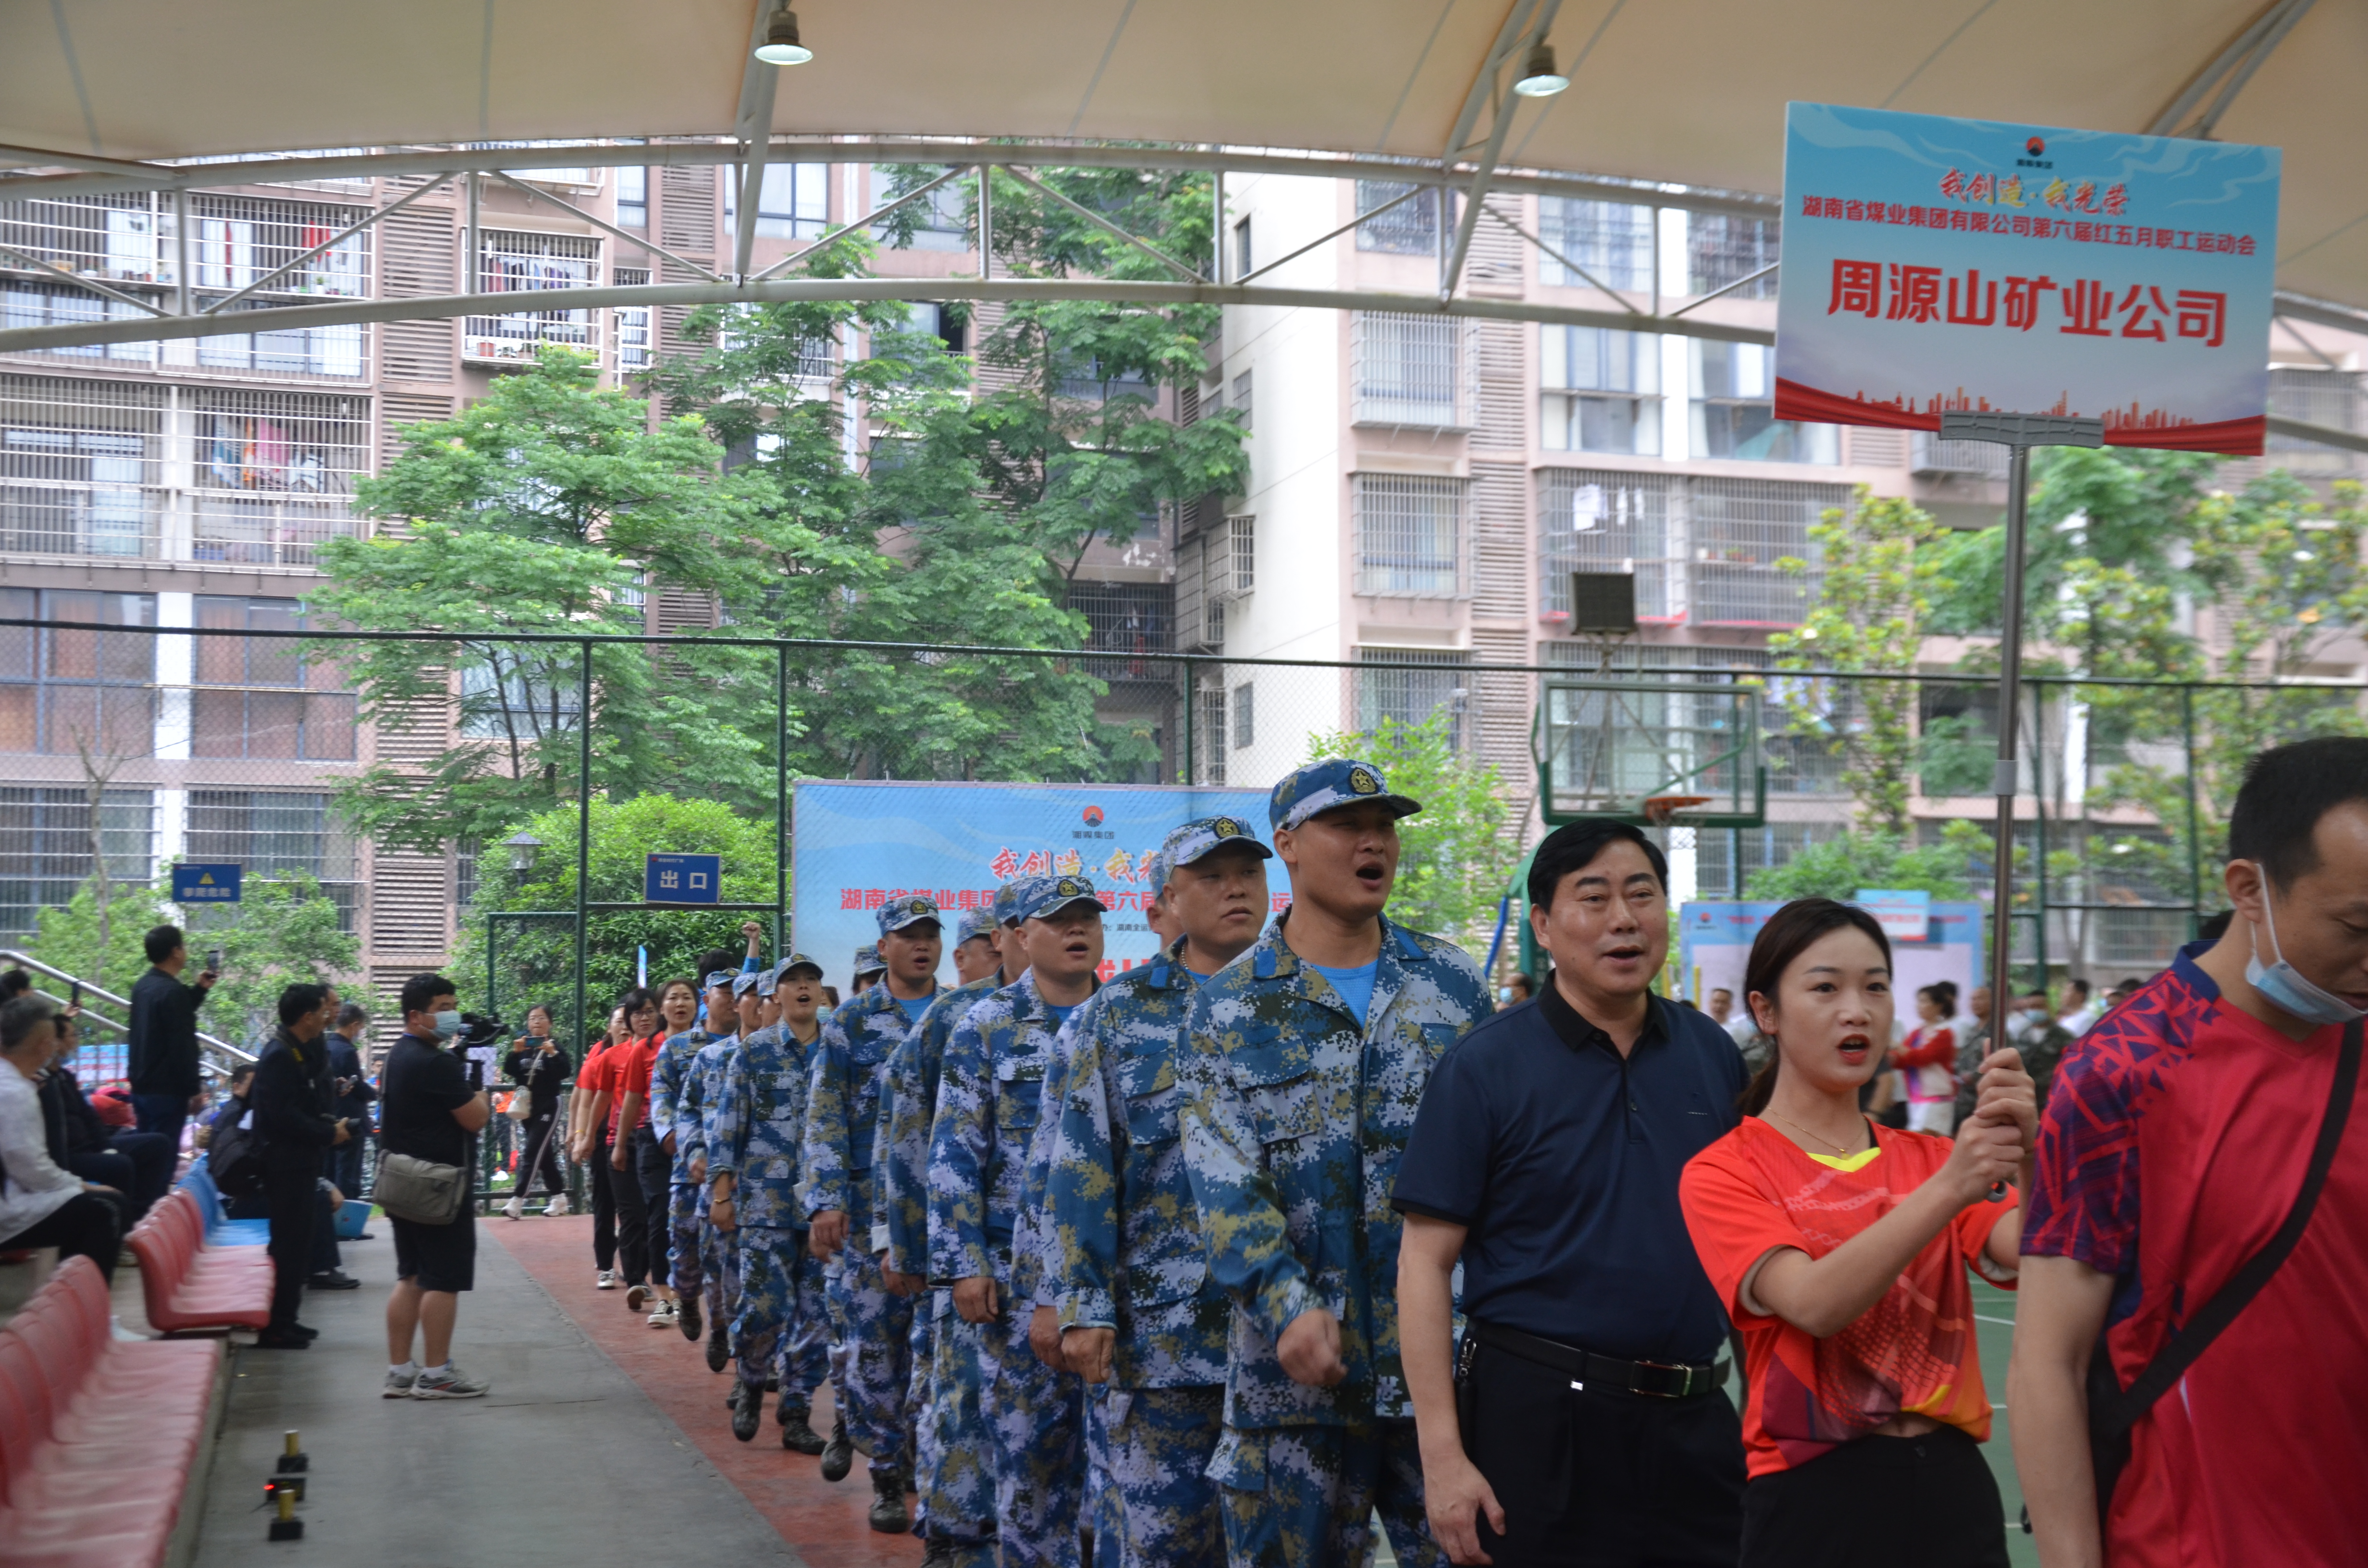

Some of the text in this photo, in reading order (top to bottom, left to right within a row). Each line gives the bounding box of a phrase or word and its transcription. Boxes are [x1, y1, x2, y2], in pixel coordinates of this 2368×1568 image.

[1802, 194, 2257, 256] 湖南省煤业集团有限公司第六届红五月职工运动会
[1827, 258, 2228, 348] 周源山矿业公司
[660, 870, 707, 889] 出口
